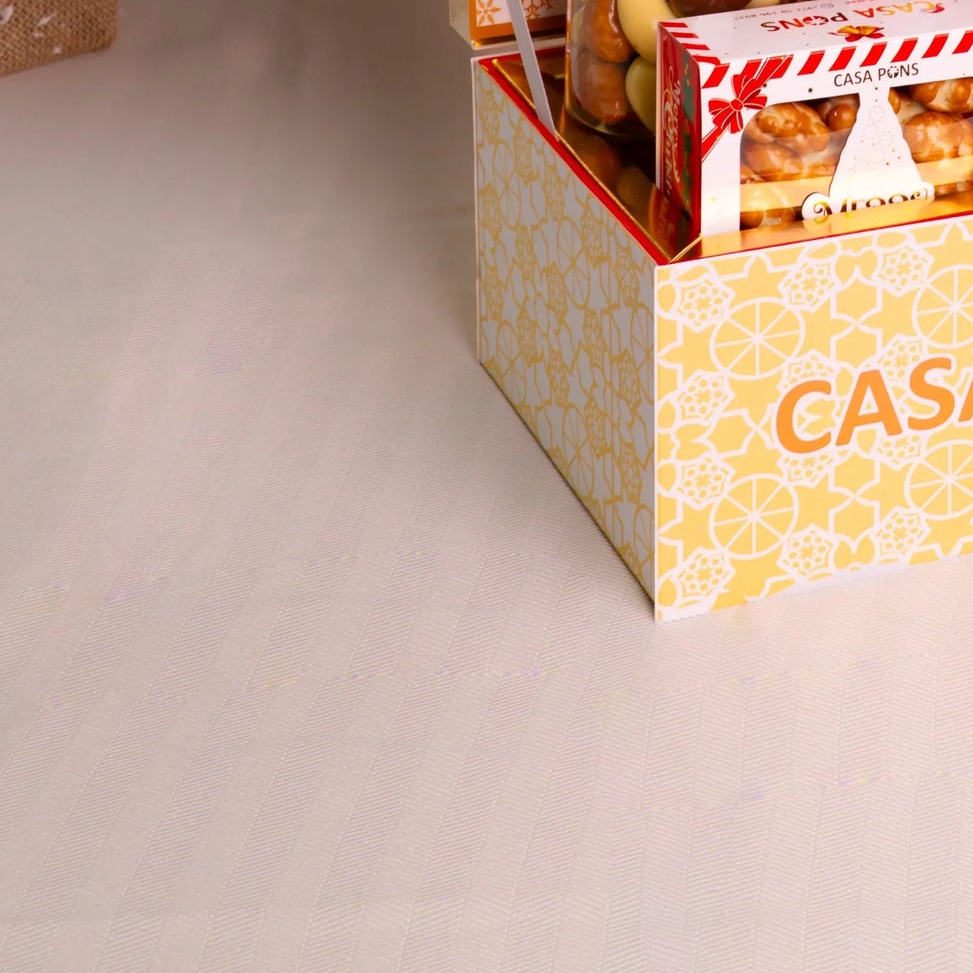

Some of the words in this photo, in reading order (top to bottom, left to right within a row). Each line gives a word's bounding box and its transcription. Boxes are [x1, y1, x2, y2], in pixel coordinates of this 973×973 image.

[853, 1, 938, 19] CASA
[760, 12, 849, 33] PONS
[833, 70, 873, 87] CASA
[877, 62, 919, 81] PONS
